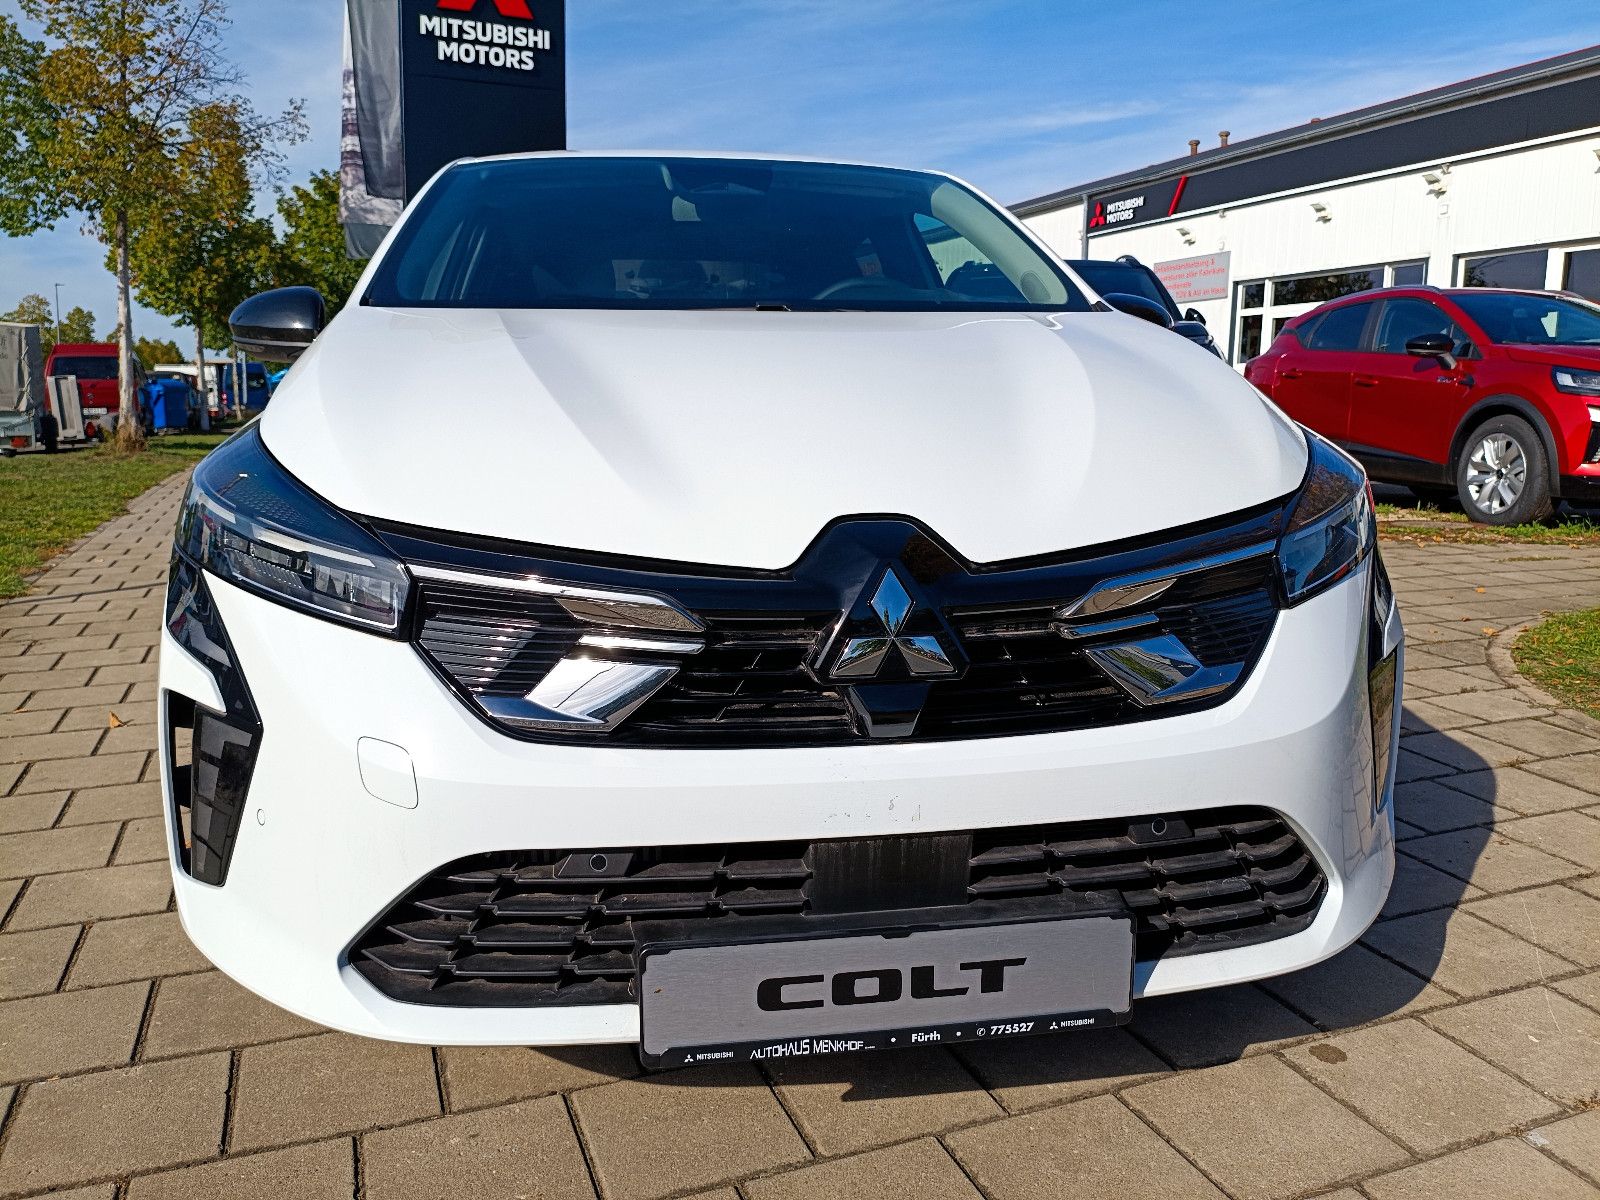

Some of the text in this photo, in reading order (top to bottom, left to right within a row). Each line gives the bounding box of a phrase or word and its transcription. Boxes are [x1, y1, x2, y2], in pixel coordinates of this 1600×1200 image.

[419, 14, 551, 50] MITSUBISHI
[437, 40, 535, 71] MOTORS
[1107, 195, 1145, 213] MITSUBISHI
[1107, 209, 1133, 224] MOTORS
[757, 957, 1027, 1011] COLT
[696, 1051, 734, 1061] MITSUBISHI
[749, 1039, 810, 1060] AUTOHAUS
[813, 1038, 864, 1054] MENKHOF
[911, 1031, 941, 1043] Fürth
[990, 1022, 1034, 1035] 775527
[1060, 1018, 1095, 1028] MITSUBISHI
